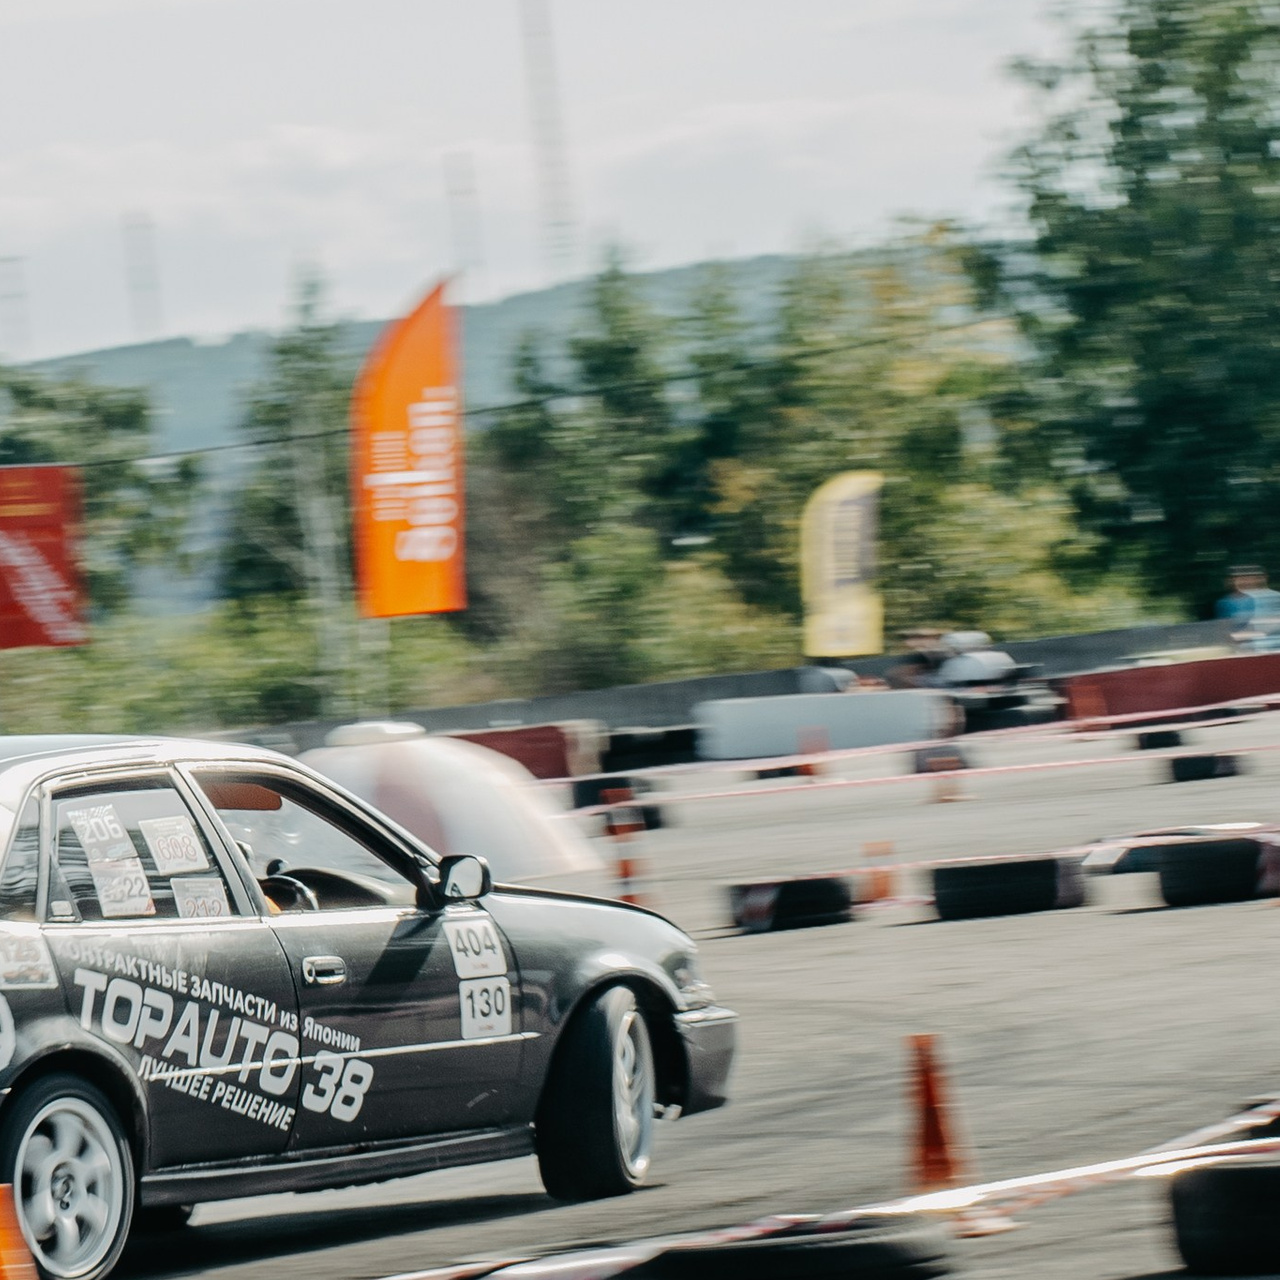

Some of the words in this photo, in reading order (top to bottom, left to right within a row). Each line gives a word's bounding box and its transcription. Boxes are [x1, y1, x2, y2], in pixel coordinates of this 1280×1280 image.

[74, 815, 124, 844] 206
[157, 835, 197, 861] 608
[456, 926, 497, 958] 404
[190, 975, 276, 1024] ЗАПЧАСТИ
[466, 986, 505, 1019] 130
[74, 968, 299, 1095] TOPAUTO
[301, 1049, 374, 1122] 38
[137, 1054, 214, 1101] ЛУЧШЕЕ
[211, 1081, 296, 1131] РЕШЕНИЕ
